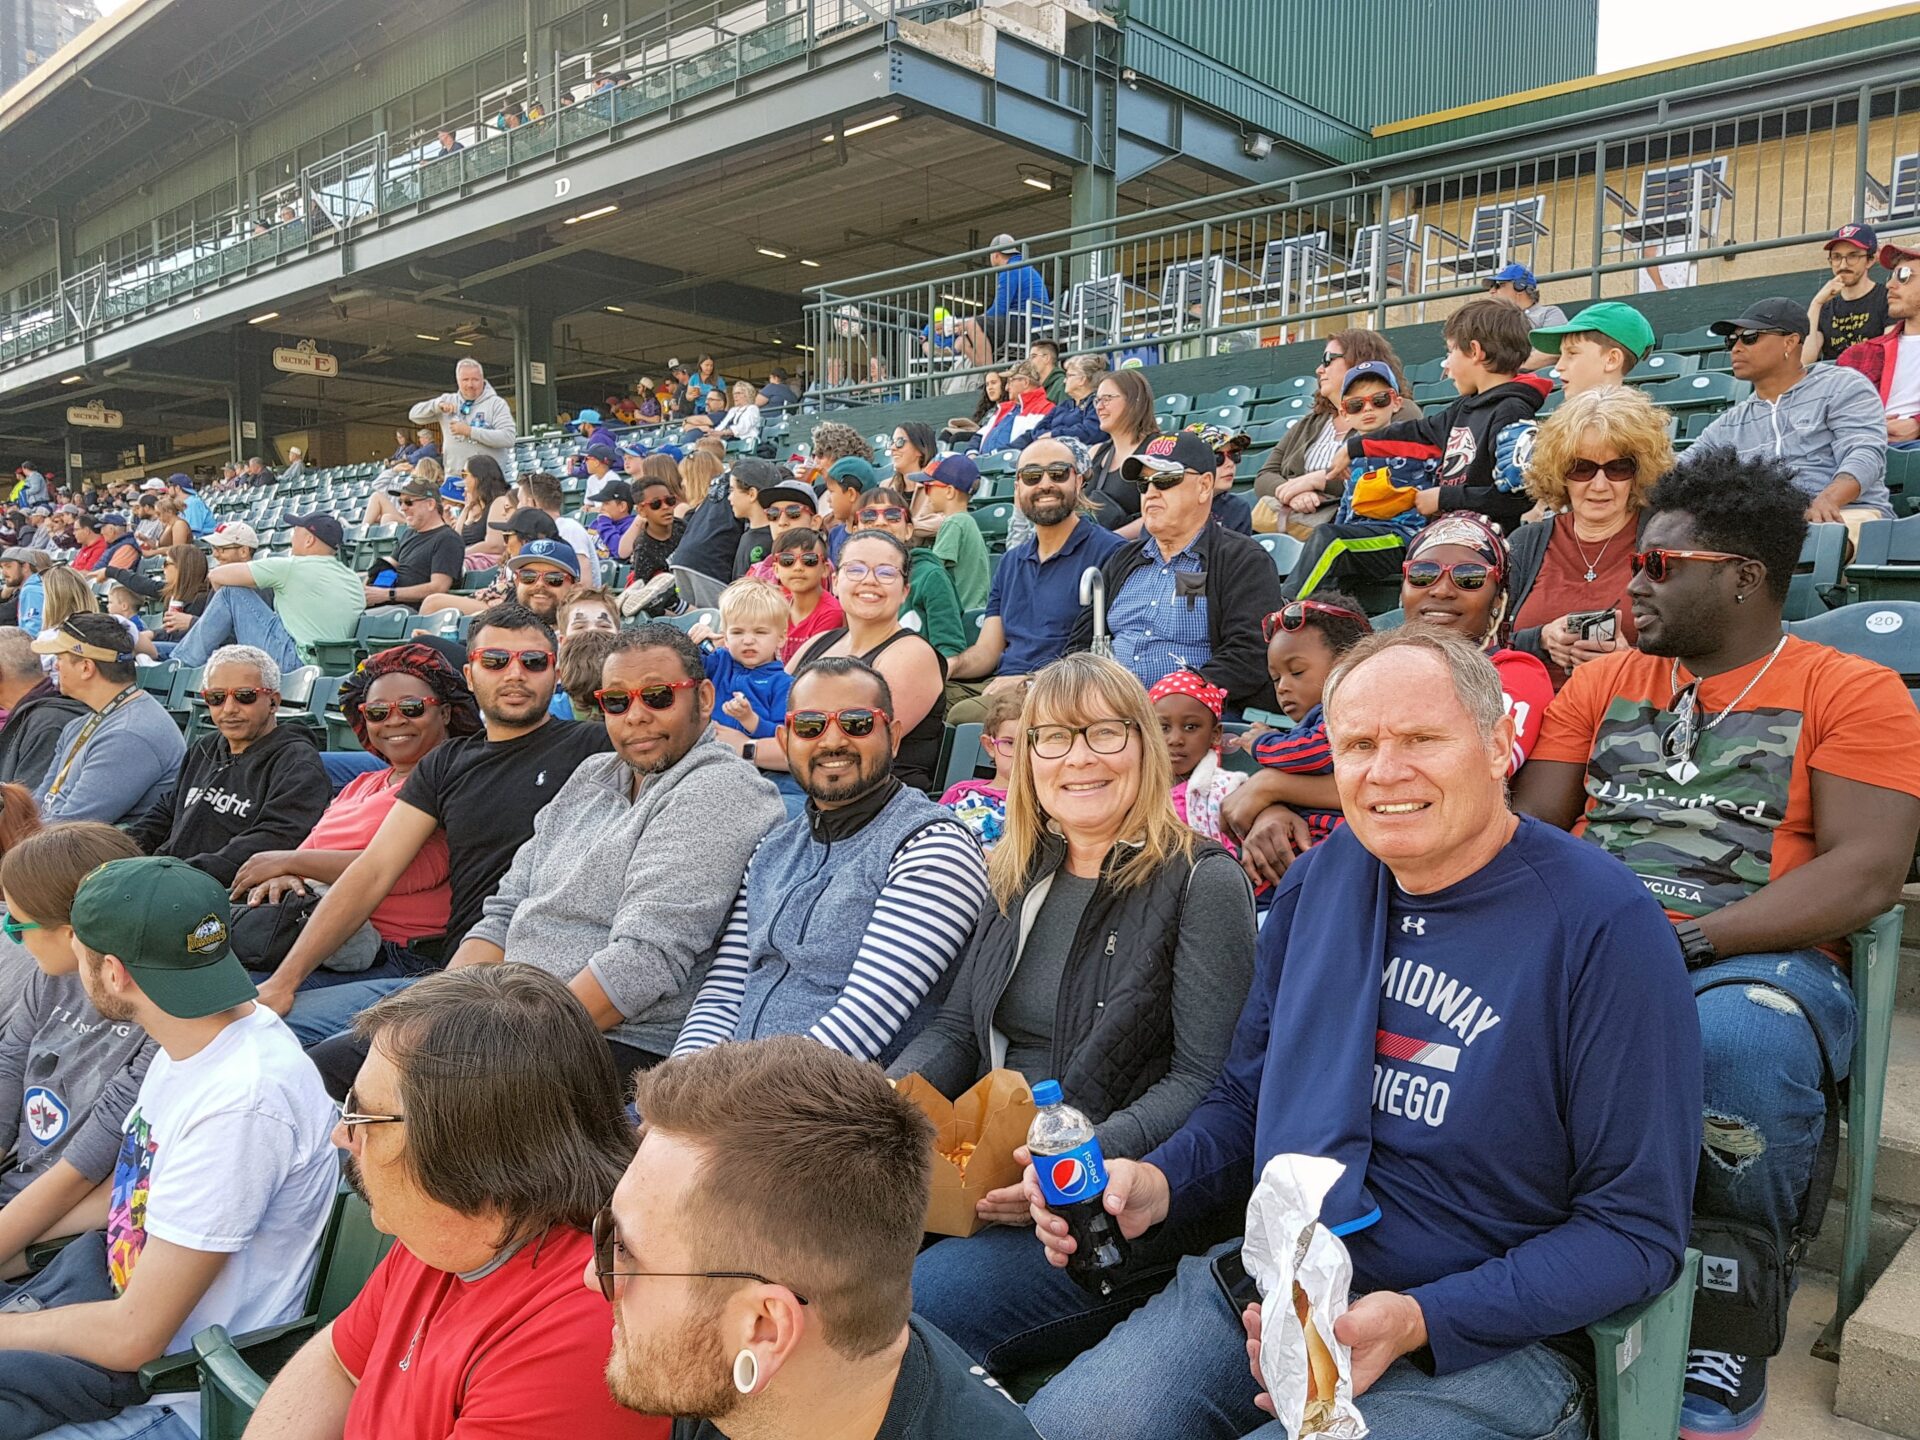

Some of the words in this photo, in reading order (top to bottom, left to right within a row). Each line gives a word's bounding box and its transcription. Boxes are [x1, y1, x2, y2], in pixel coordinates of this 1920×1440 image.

[555, 177, 570, 198] D
[280, 355, 311, 366] SECTION
[314, 357, 331, 372] E
[103, 412, 117, 424] F
[1874, 616, 1894, 626] 20
[1597, 780, 1766, 818] Unlted
[1082, 1151, 1101, 1184] pepsi
[1707, 1278, 1733, 1287] adidas
